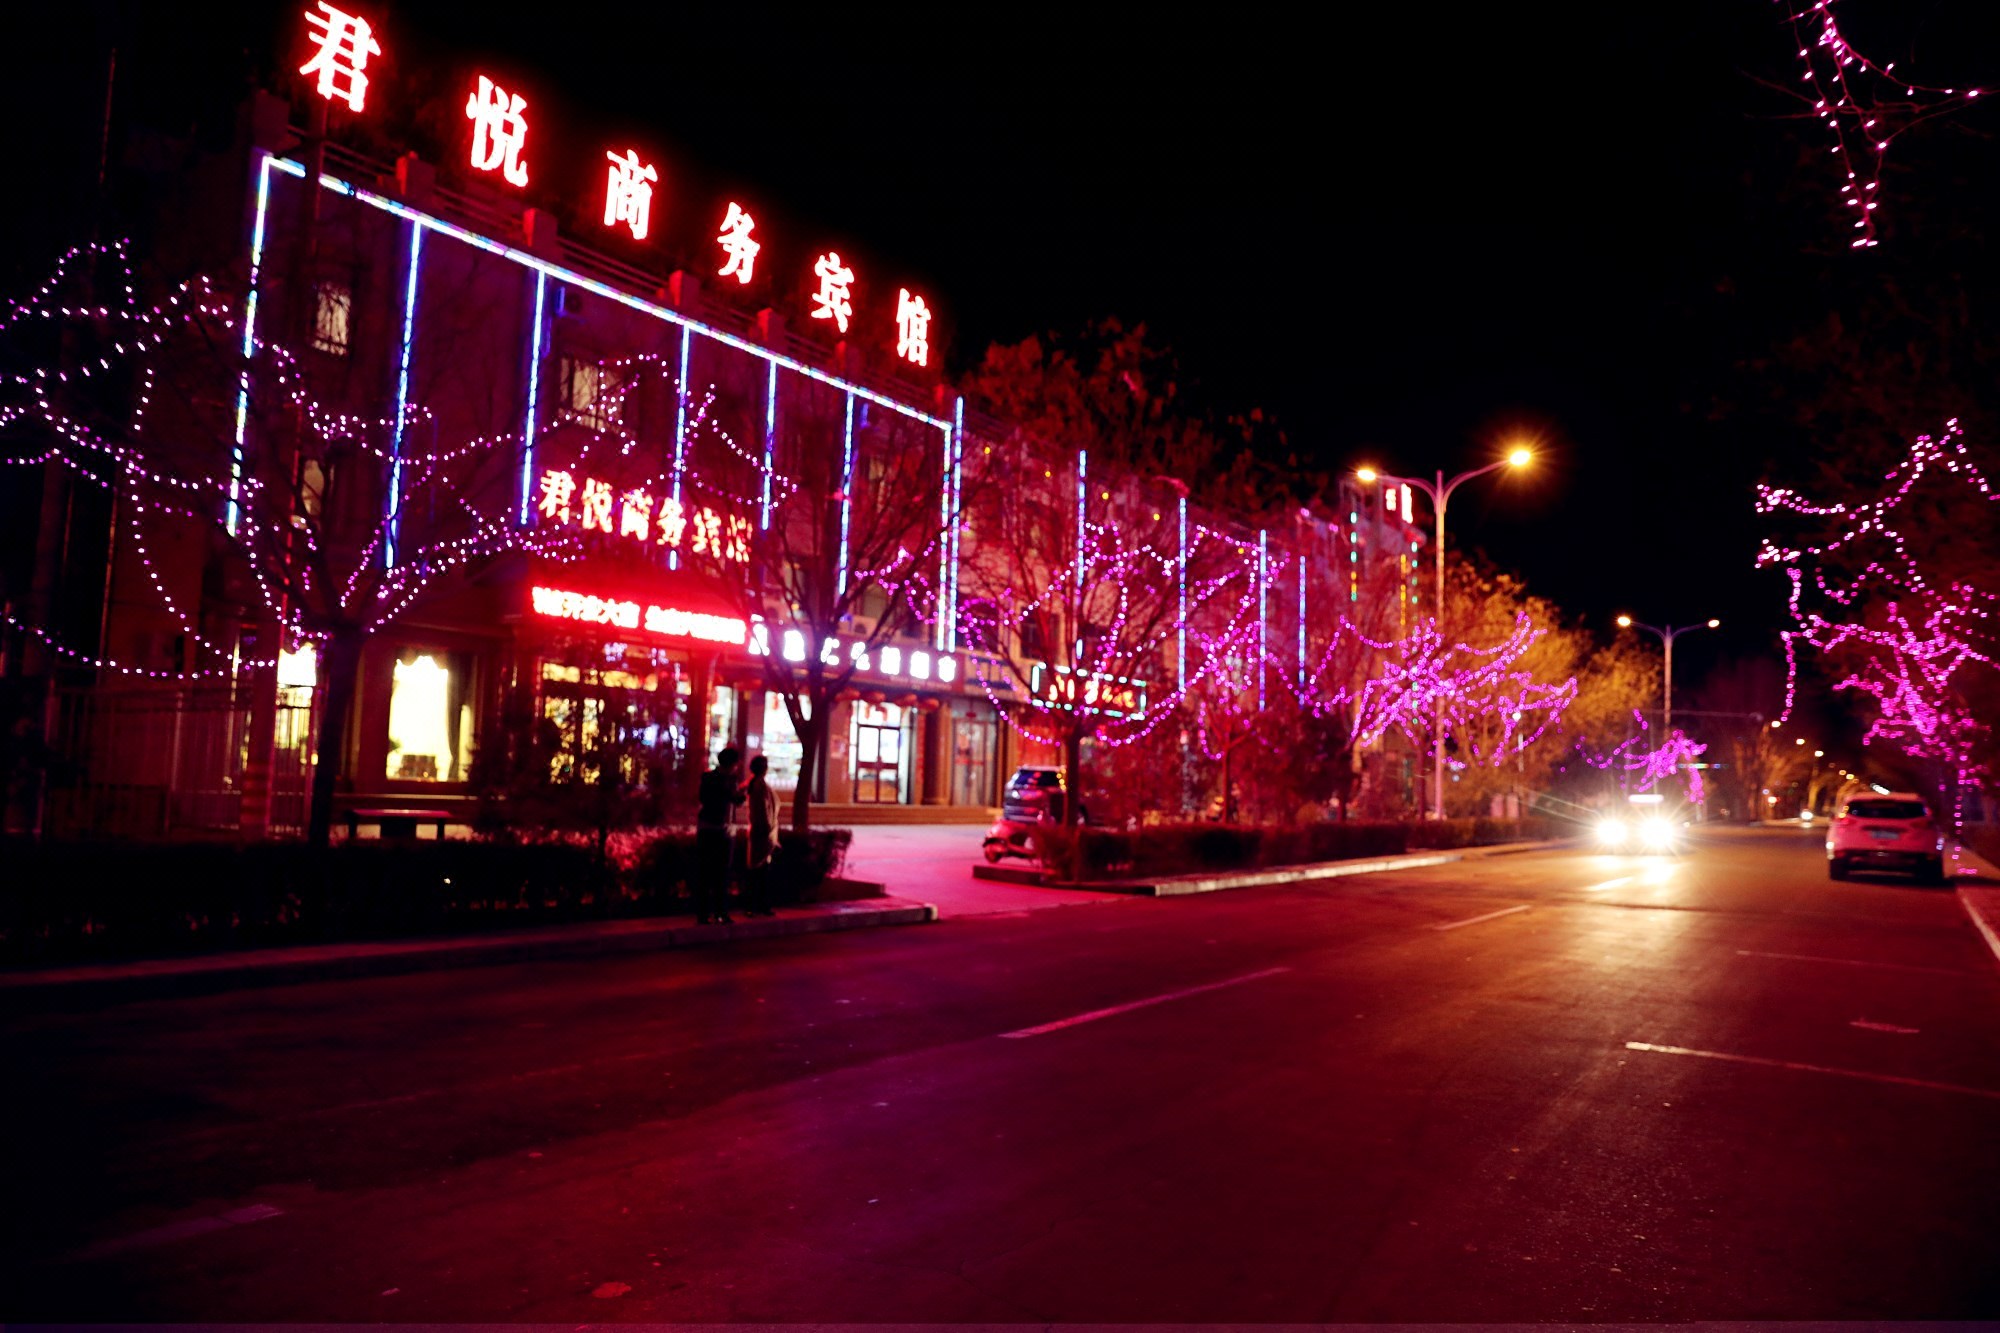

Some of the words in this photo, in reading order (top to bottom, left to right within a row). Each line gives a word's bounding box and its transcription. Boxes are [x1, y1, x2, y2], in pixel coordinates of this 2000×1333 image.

[299, 0, 932, 366] 君悦商务宾馆
